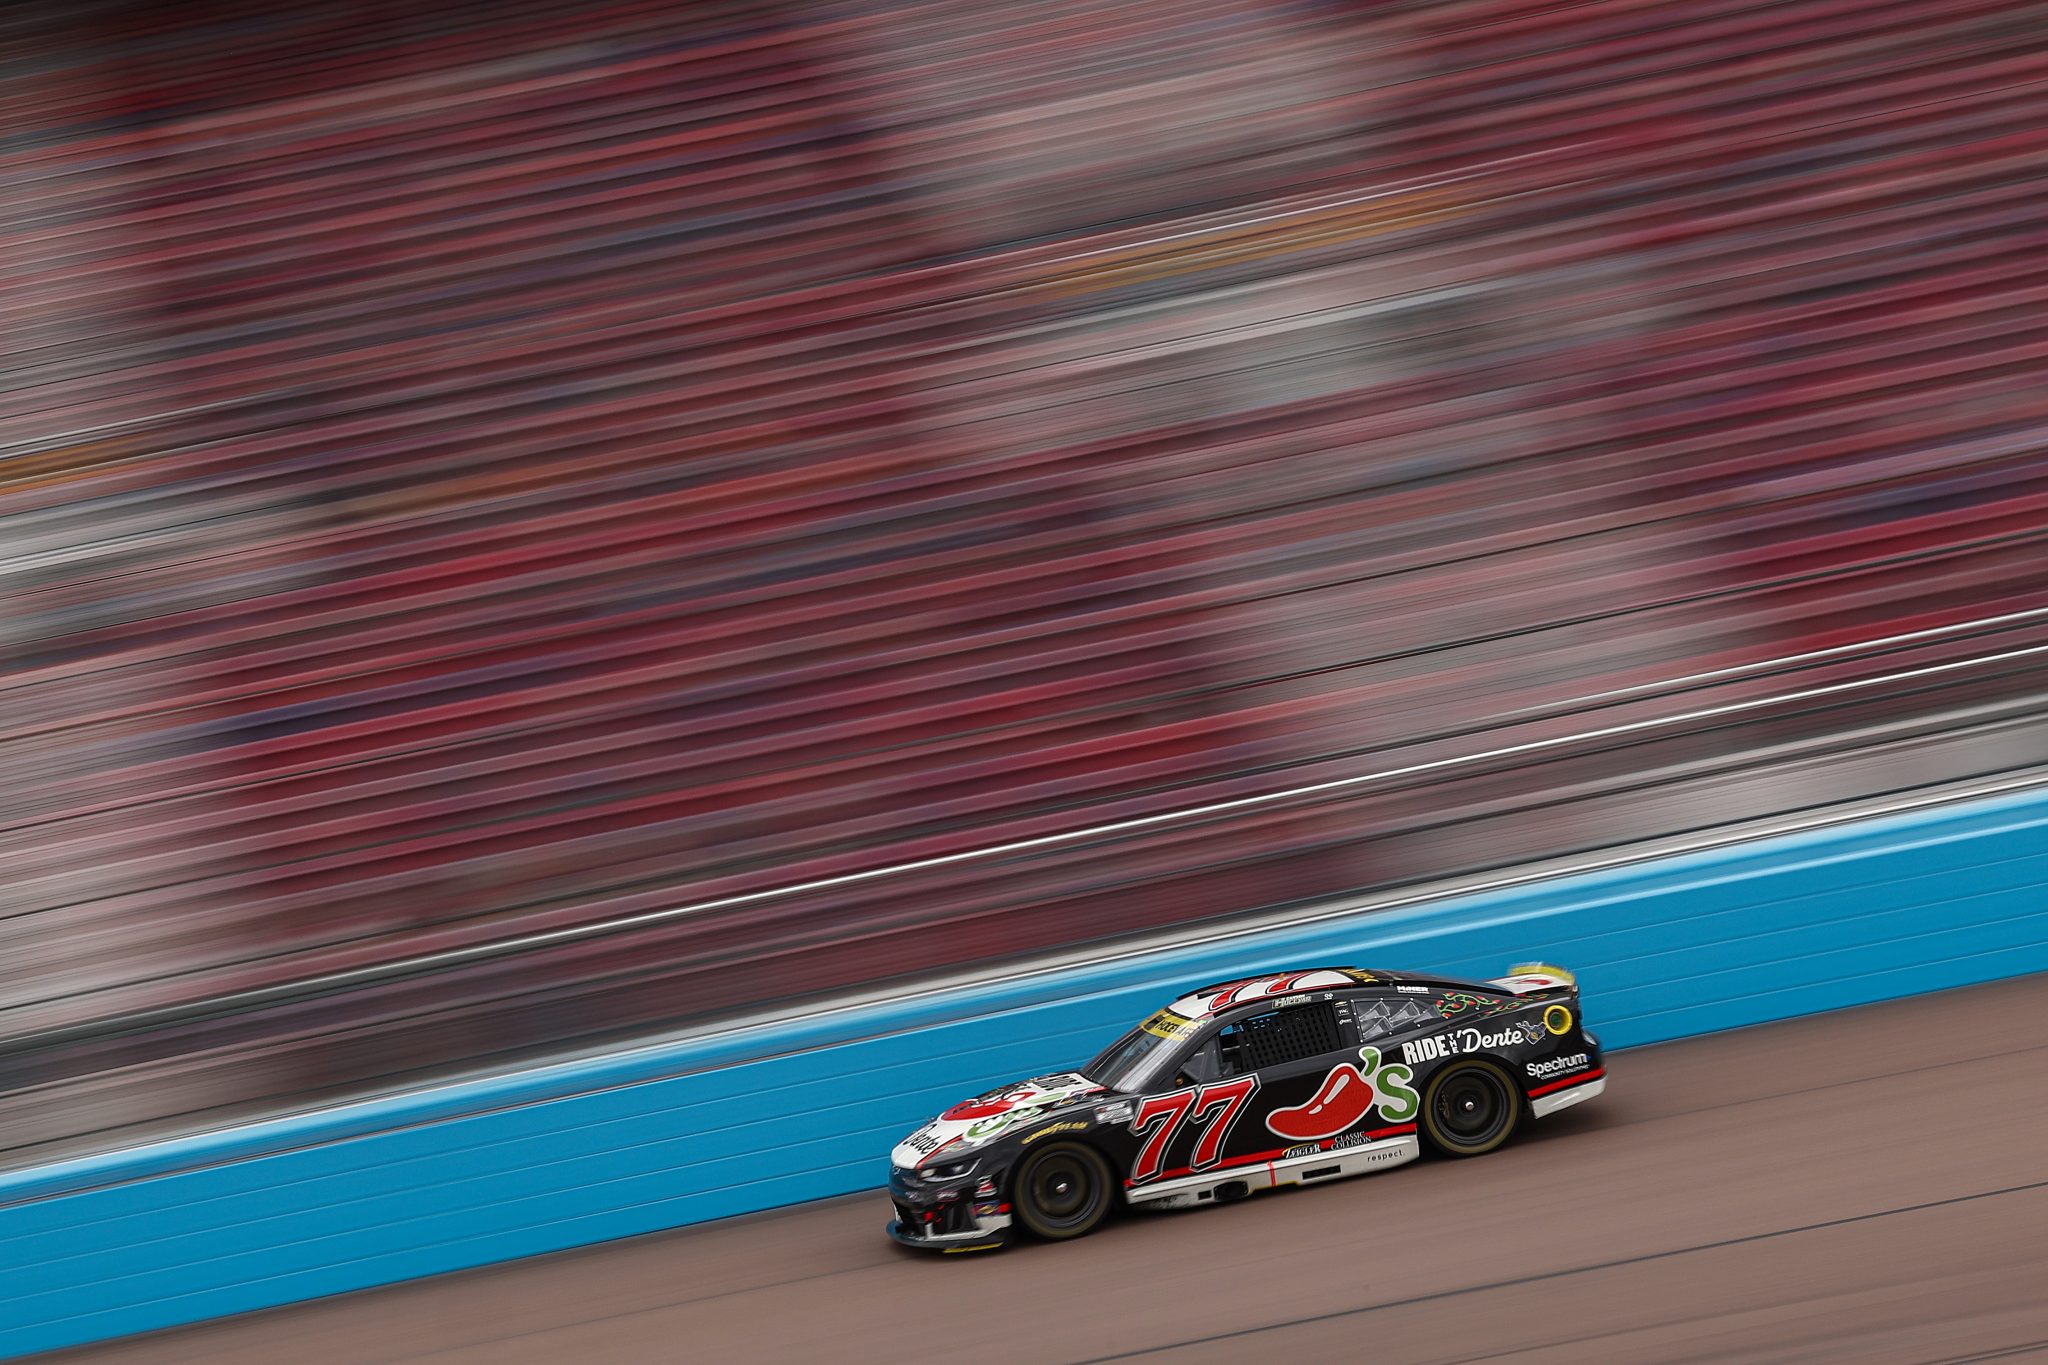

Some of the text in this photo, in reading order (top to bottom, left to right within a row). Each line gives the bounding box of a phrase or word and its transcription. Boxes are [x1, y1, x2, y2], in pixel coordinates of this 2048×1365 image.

[1401, 1034, 1450, 1065] RIDE
[1447, 1033, 1460, 1054] THE
[1526, 1053, 1588, 1078] Spectrum
[1128, 1072, 1262, 1185] 77
[1334, 1131, 1365, 1143] CLASSIC
[1330, 1136, 1372, 1151] COLLISION
